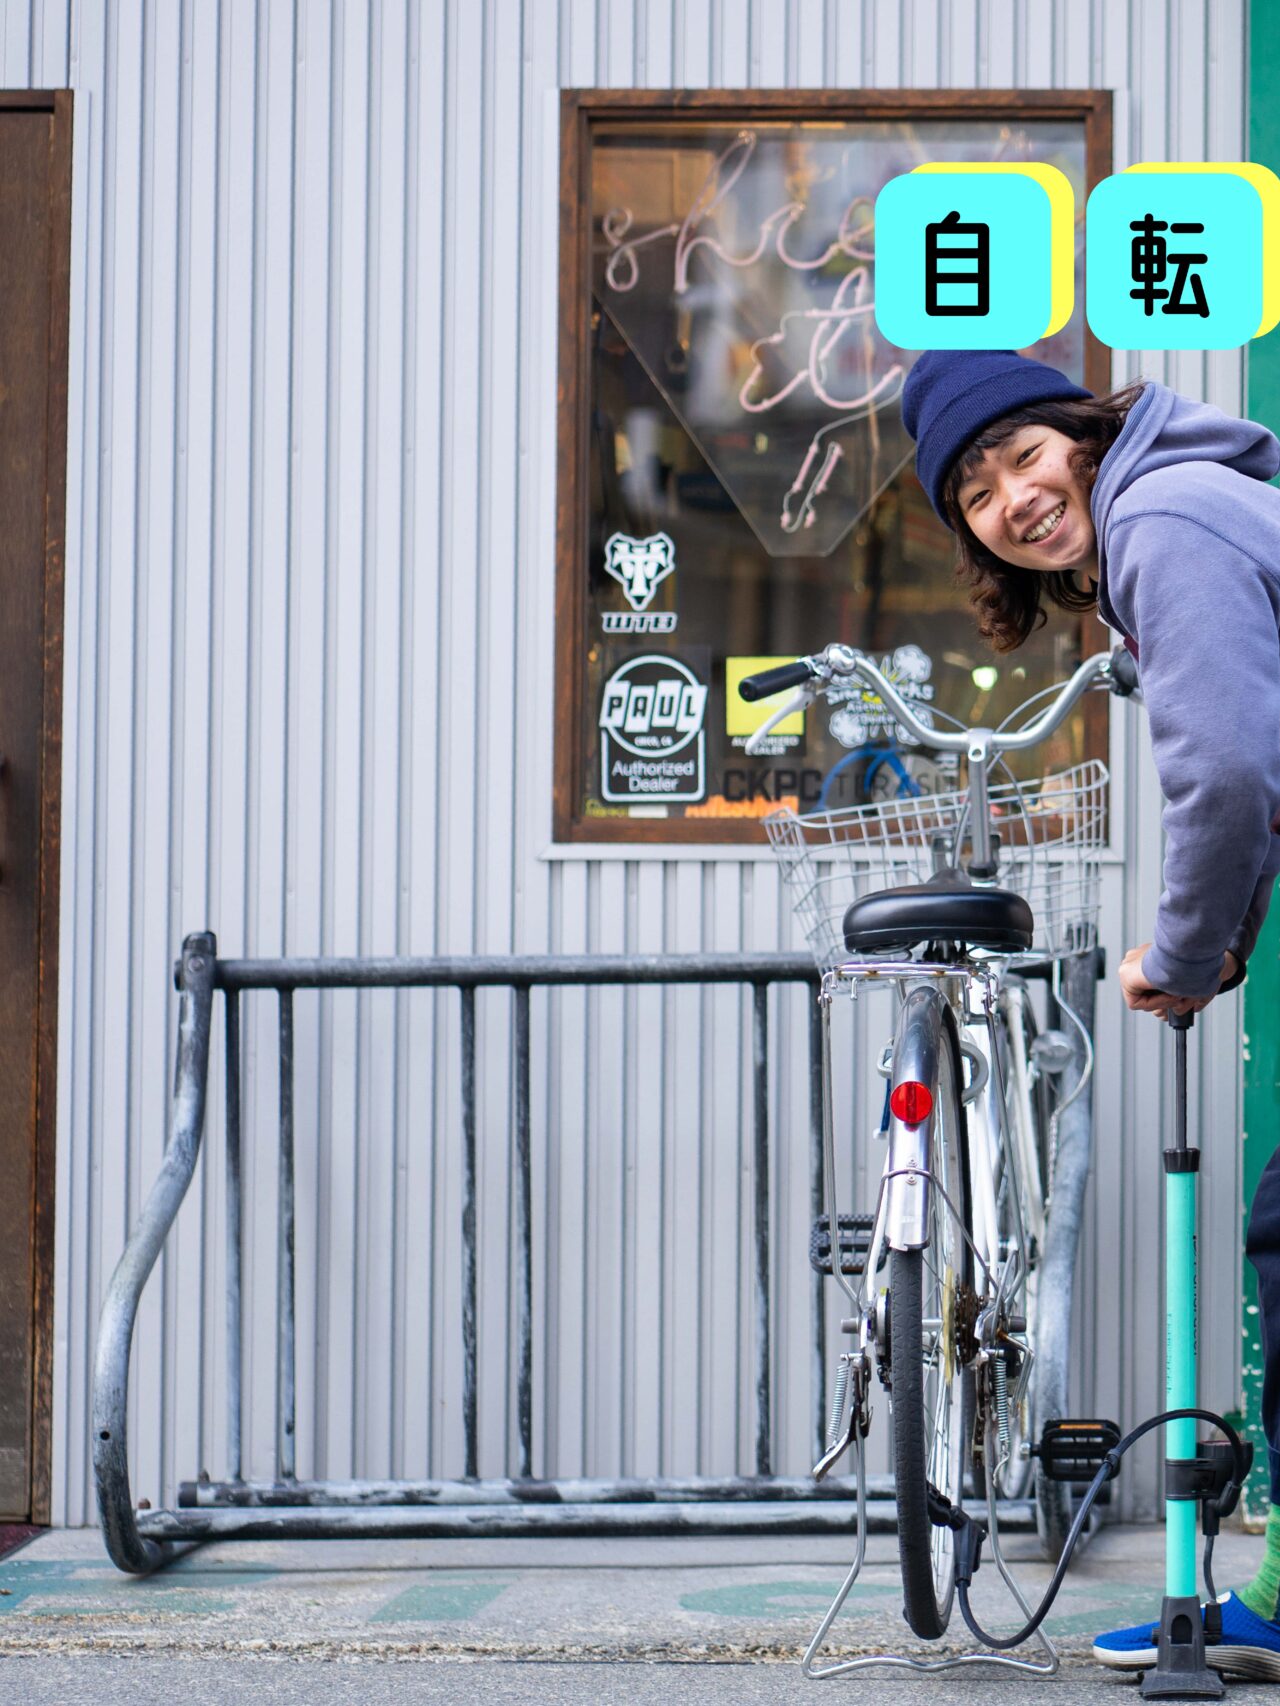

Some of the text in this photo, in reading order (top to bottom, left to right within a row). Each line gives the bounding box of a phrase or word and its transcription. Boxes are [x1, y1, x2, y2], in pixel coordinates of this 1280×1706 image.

[611, 760, 695, 777] Authorized
[628, 777, 680, 792] Dealer
[724, 769, 822, 803] CKPC
